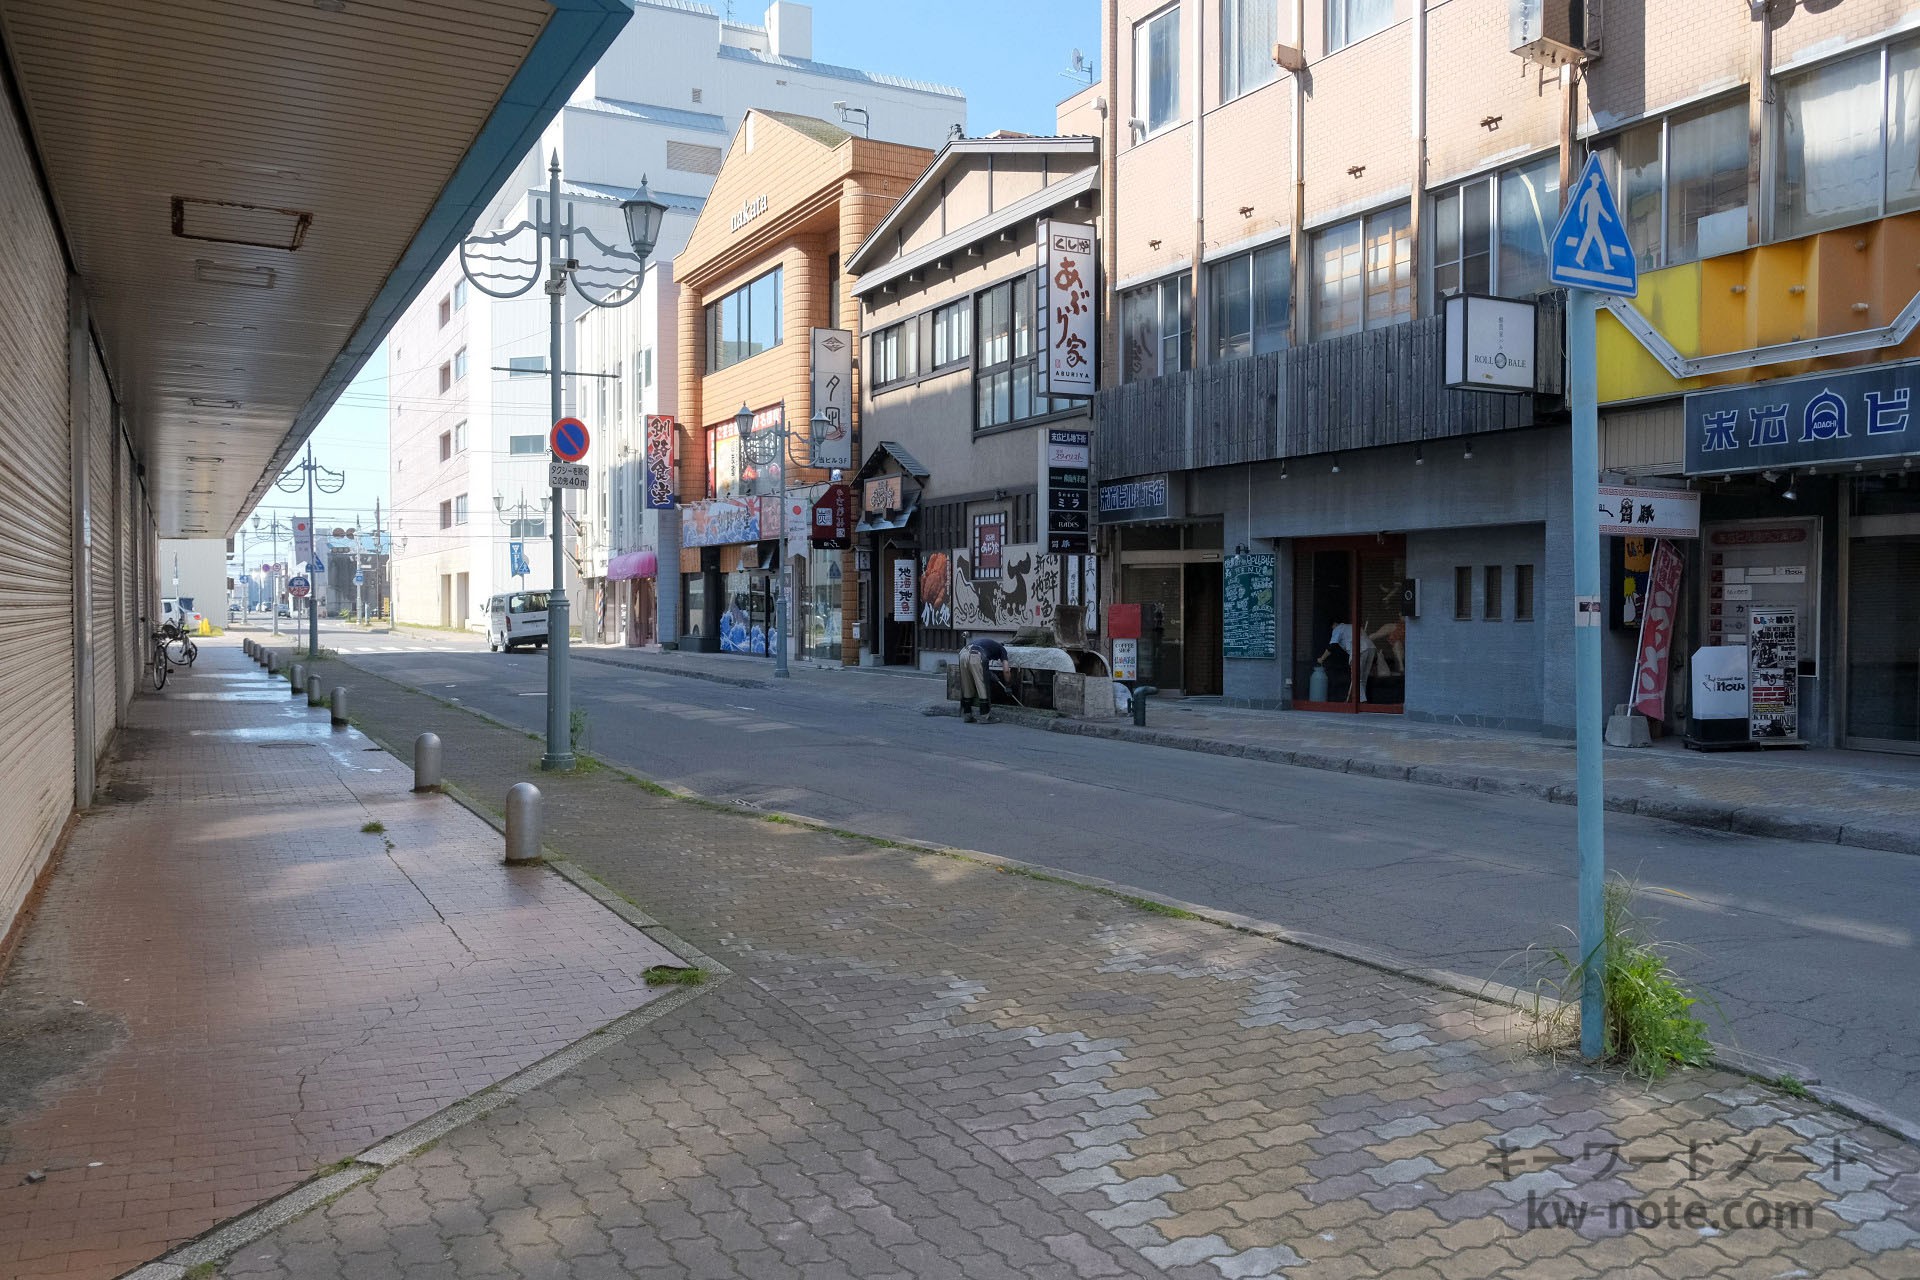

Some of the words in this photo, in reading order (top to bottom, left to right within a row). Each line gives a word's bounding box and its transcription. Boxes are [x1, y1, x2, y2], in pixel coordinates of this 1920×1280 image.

[731, 194, 768, 232] nakata
[1054, 256, 1090, 368] あぶり家
[1474, 354, 1494, 366] ROLL
[1508, 357, 1527, 369] BALE
[1055, 370, 1090, 379] ABURIYA
[1813, 419, 1838, 429] ADACHI
[650, 417, 672, 505] 釧路食堂
[551, 465, 589, 476] タクシーを除く
